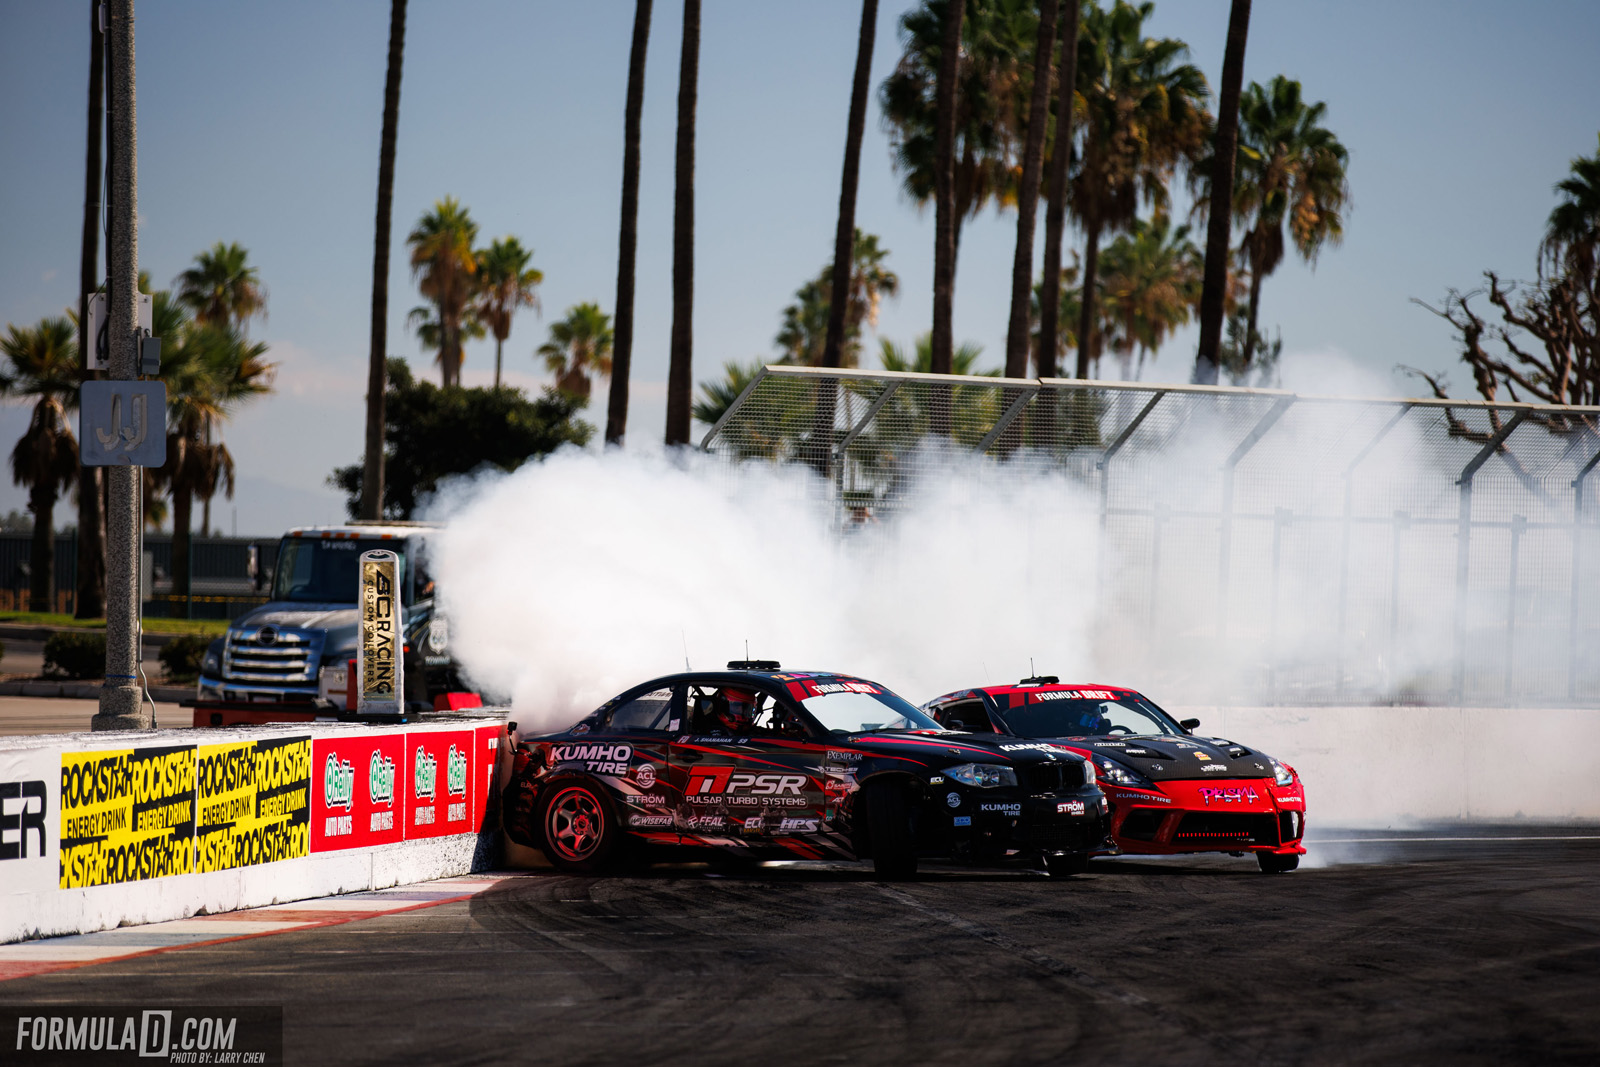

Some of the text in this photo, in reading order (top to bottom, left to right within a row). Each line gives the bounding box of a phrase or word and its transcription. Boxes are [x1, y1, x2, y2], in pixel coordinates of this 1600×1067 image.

[366, 580, 375, 684] CUSTOM COILOVERS
[1035, 690, 1115, 702] FORMULA DRIFT
[549, 745, 631, 761] KUMHO
[198, 739, 312, 799] ROCKSTAR ROCKSTAR
[586, 761, 628, 775] TIRE
[61, 748, 197, 810] ROCKSTAR ROCKSTAR
[726, 774, 807, 795] PSR
[260, 787, 307, 818] ENERGY DRINK
[686, 795, 806, 806] PULSAR TURBO SYSTEMS
[1151, 795, 1172, 804] TIRE
[1198, 785, 1260, 806] PRISMA
[138, 800, 192, 831] ENERGY DRINK
[202, 794, 251, 826] ENERGY DRINK
[981, 803, 1021, 811] KUMHO
[1057, 800, 1085, 814] STRÖM
[67, 806, 127, 839] ENERGY DRINK
[325, 815, 353, 837] AUTO PARTS
[641, 816, 673, 825] WISEFAB
[780, 819, 820, 832] HPS
